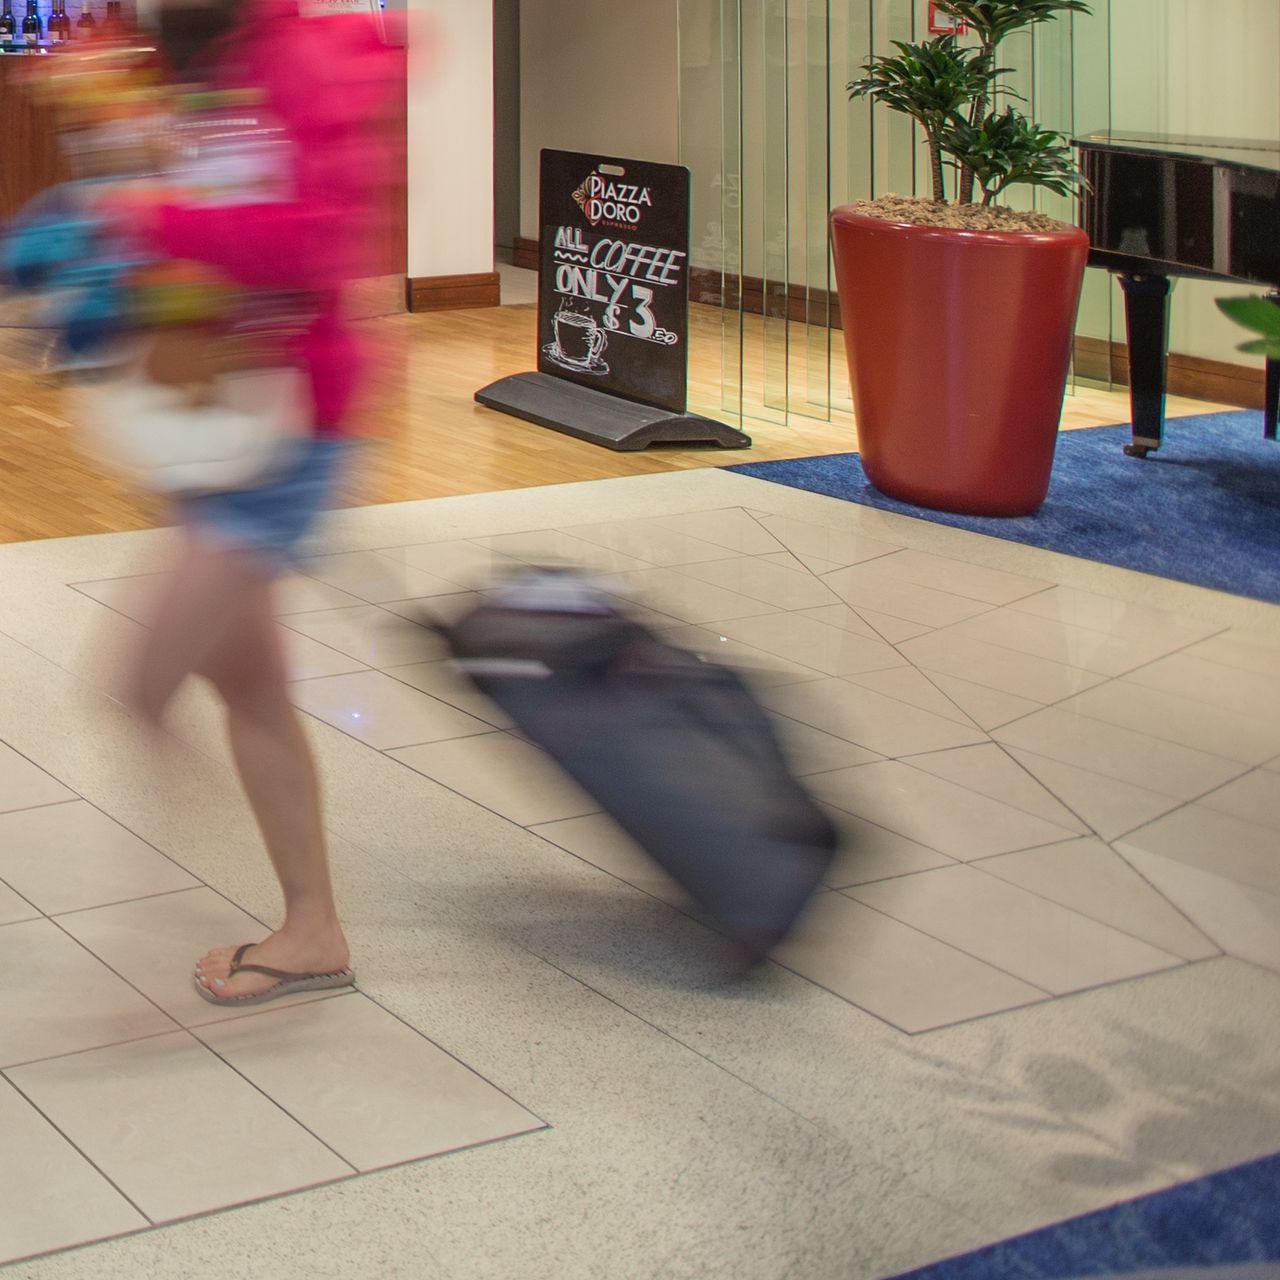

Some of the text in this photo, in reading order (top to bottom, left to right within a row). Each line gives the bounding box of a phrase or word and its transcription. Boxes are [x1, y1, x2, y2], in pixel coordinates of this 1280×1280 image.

[591, 175, 652, 206] PIAZZA
[591, 199, 640, 223] DORO
[555, 226, 687, 285] ALL COFFEE
[556, 264, 629, 304] ONLY
